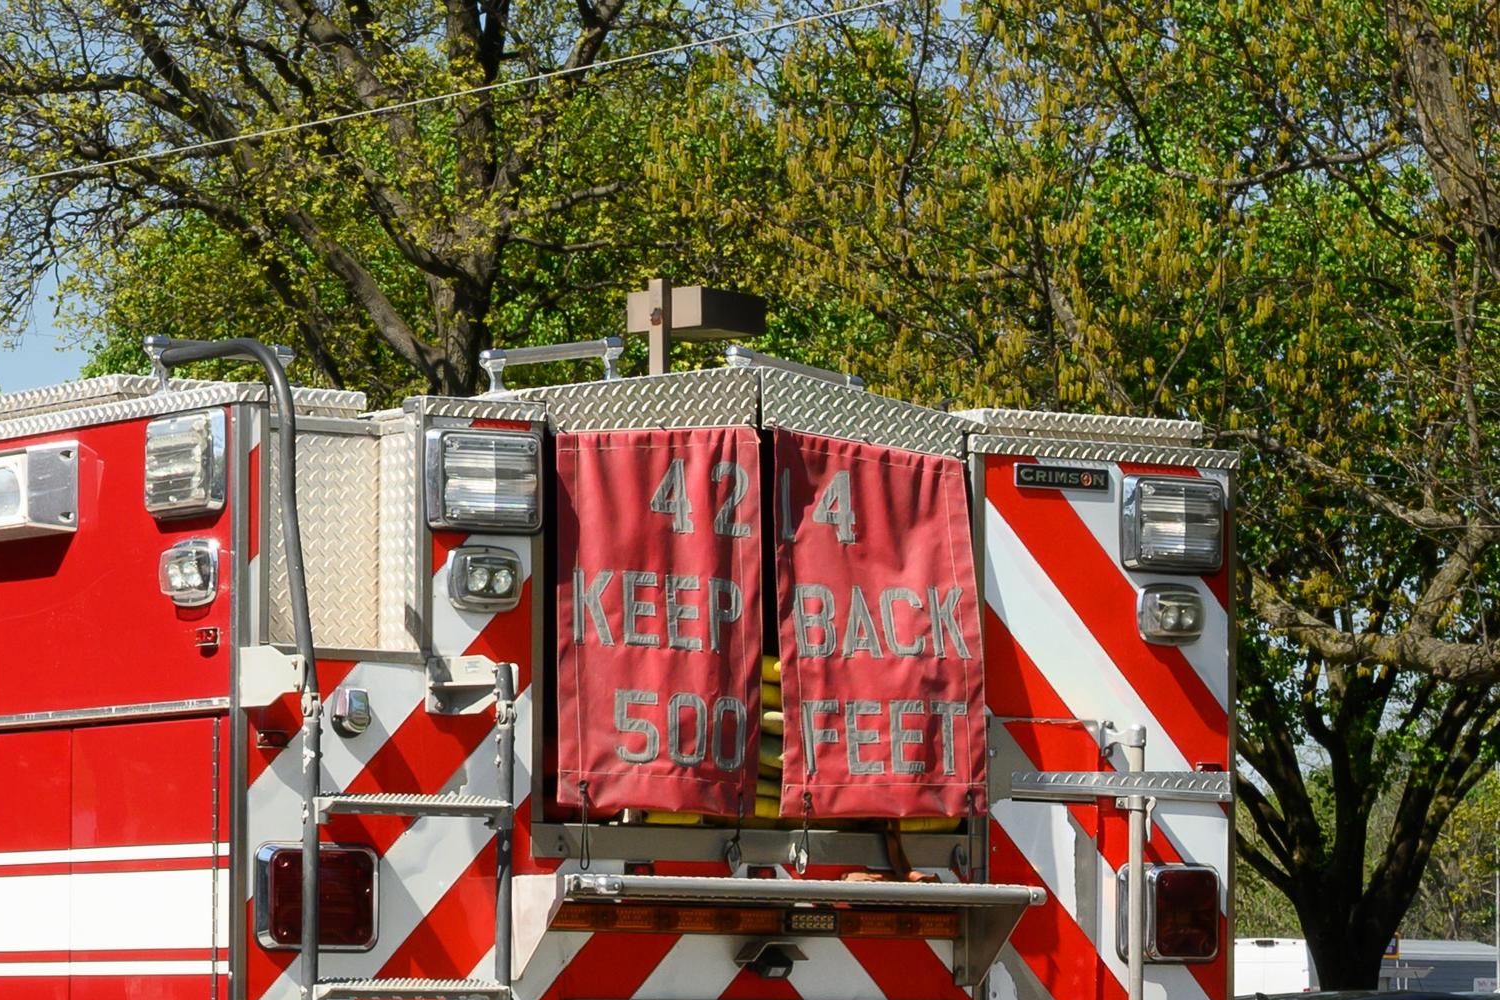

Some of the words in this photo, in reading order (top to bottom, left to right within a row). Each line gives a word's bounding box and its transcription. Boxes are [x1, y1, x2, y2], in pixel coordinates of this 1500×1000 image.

[1020, 468, 1105, 487] CRIMSON
[573, 569, 743, 653] KEEP
[794, 584, 972, 660] BACK
[614, 688, 746, 772] 500
[803, 700, 968, 776] FEET
